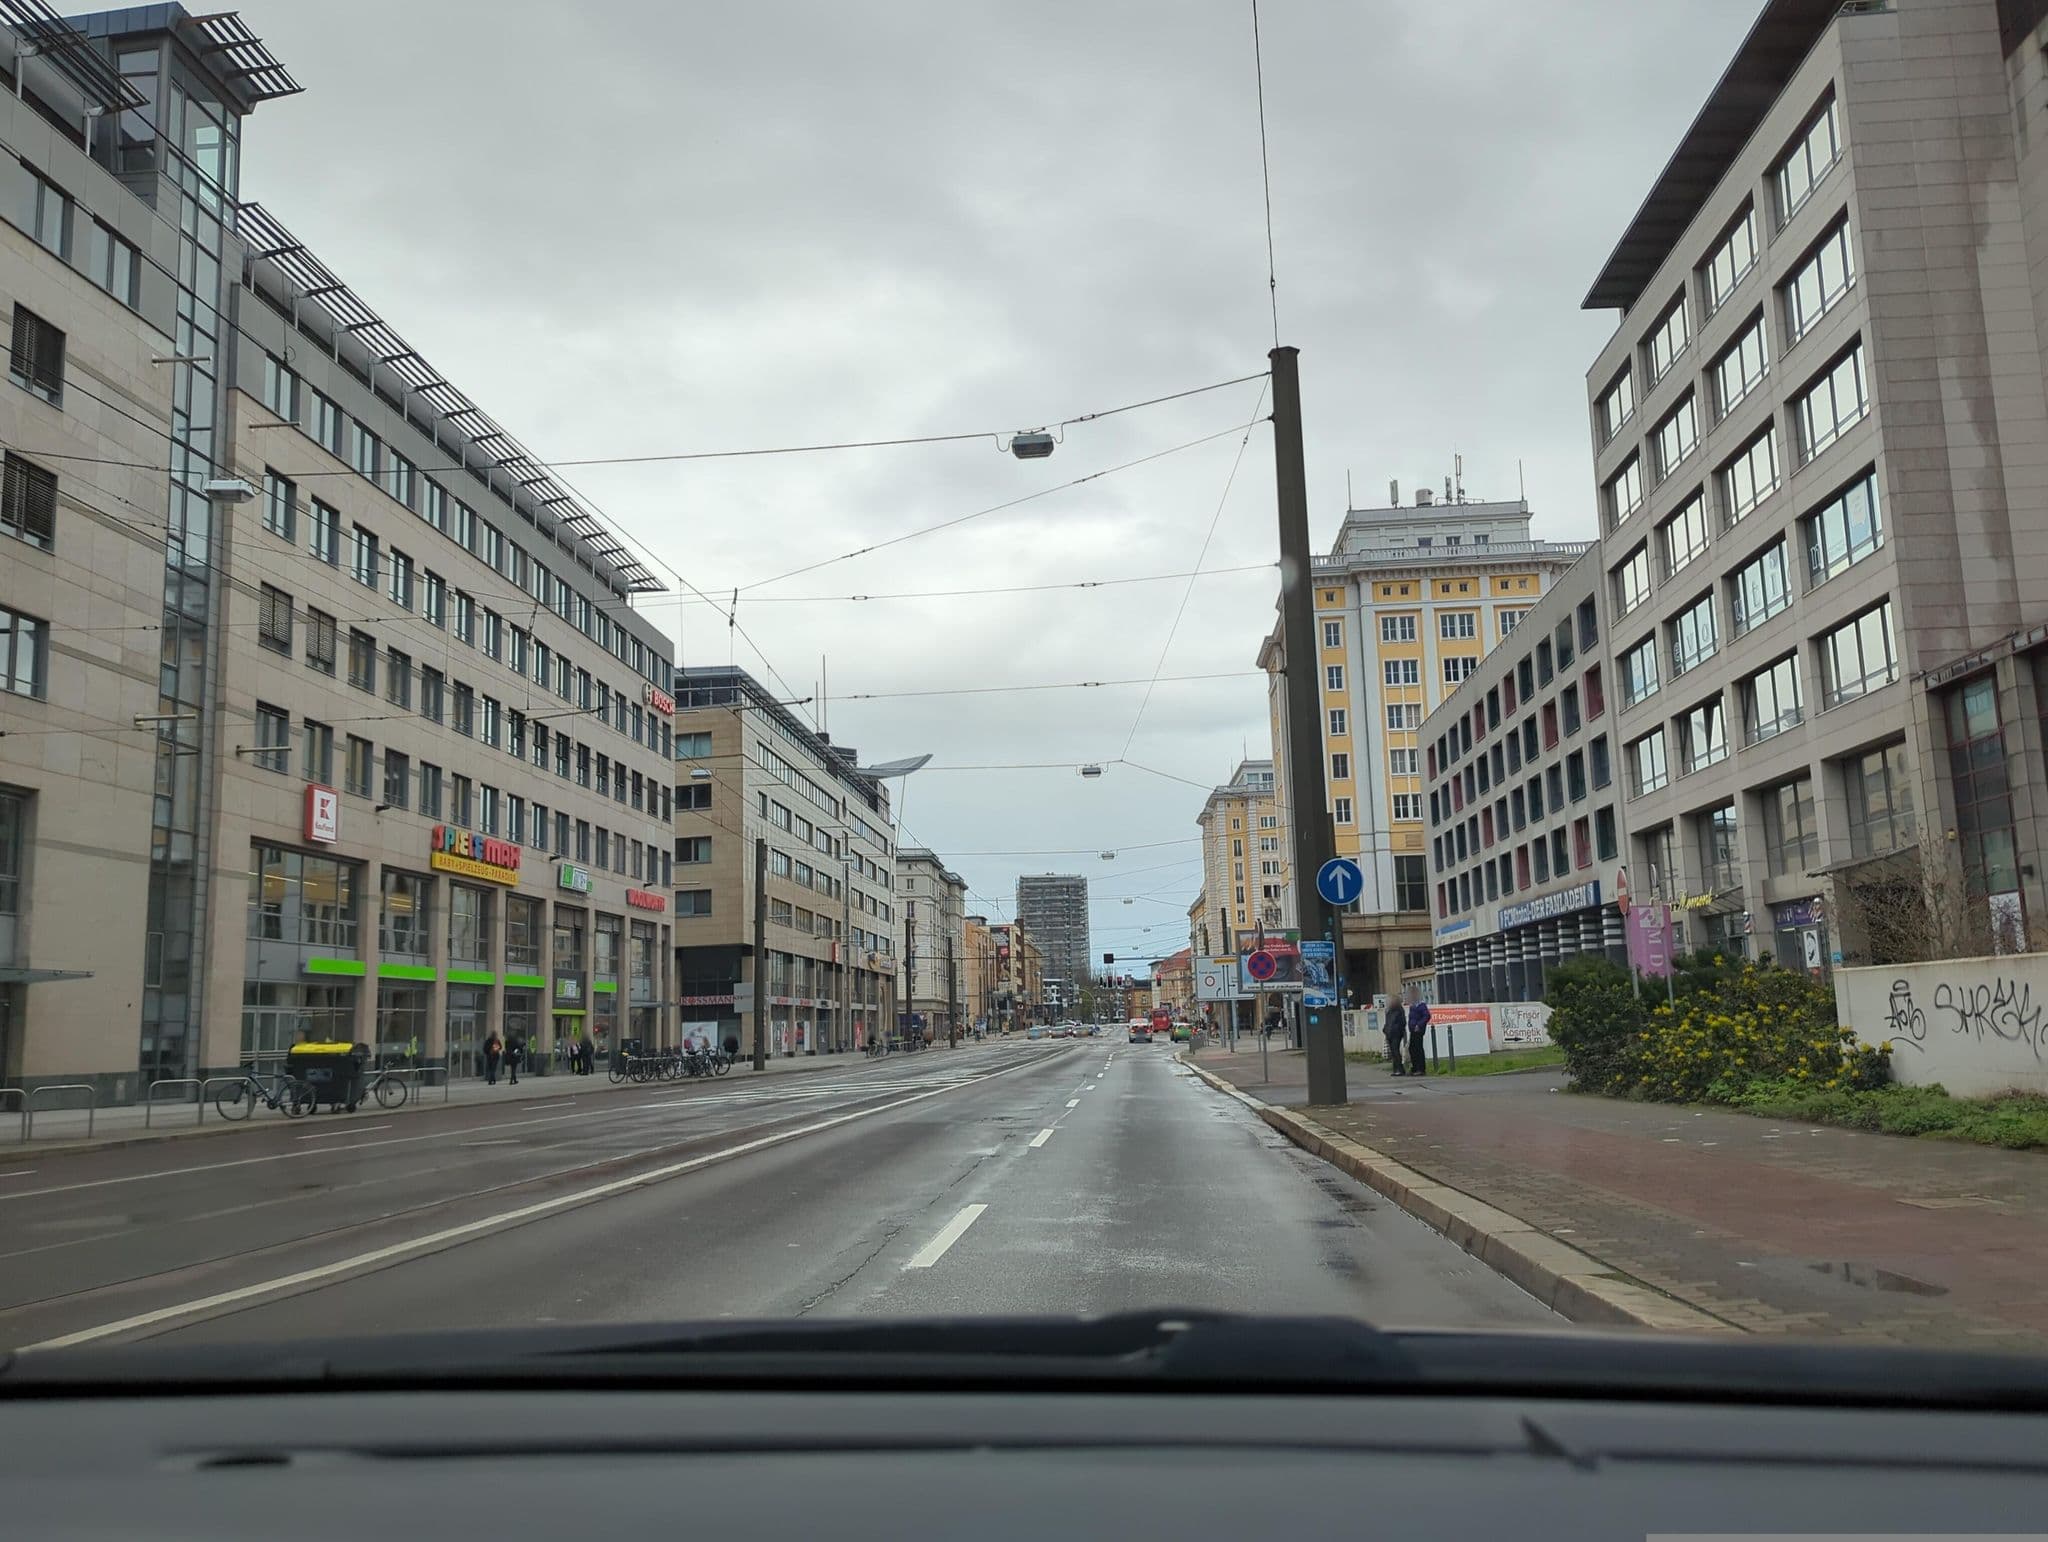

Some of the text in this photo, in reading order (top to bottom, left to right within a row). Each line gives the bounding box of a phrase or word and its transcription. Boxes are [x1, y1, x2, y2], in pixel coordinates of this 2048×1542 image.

[653, 689, 675, 717] BOSCH
[485, 838, 521, 869] MAX
[1503, 1028, 1542, 1037] Kosmetik
